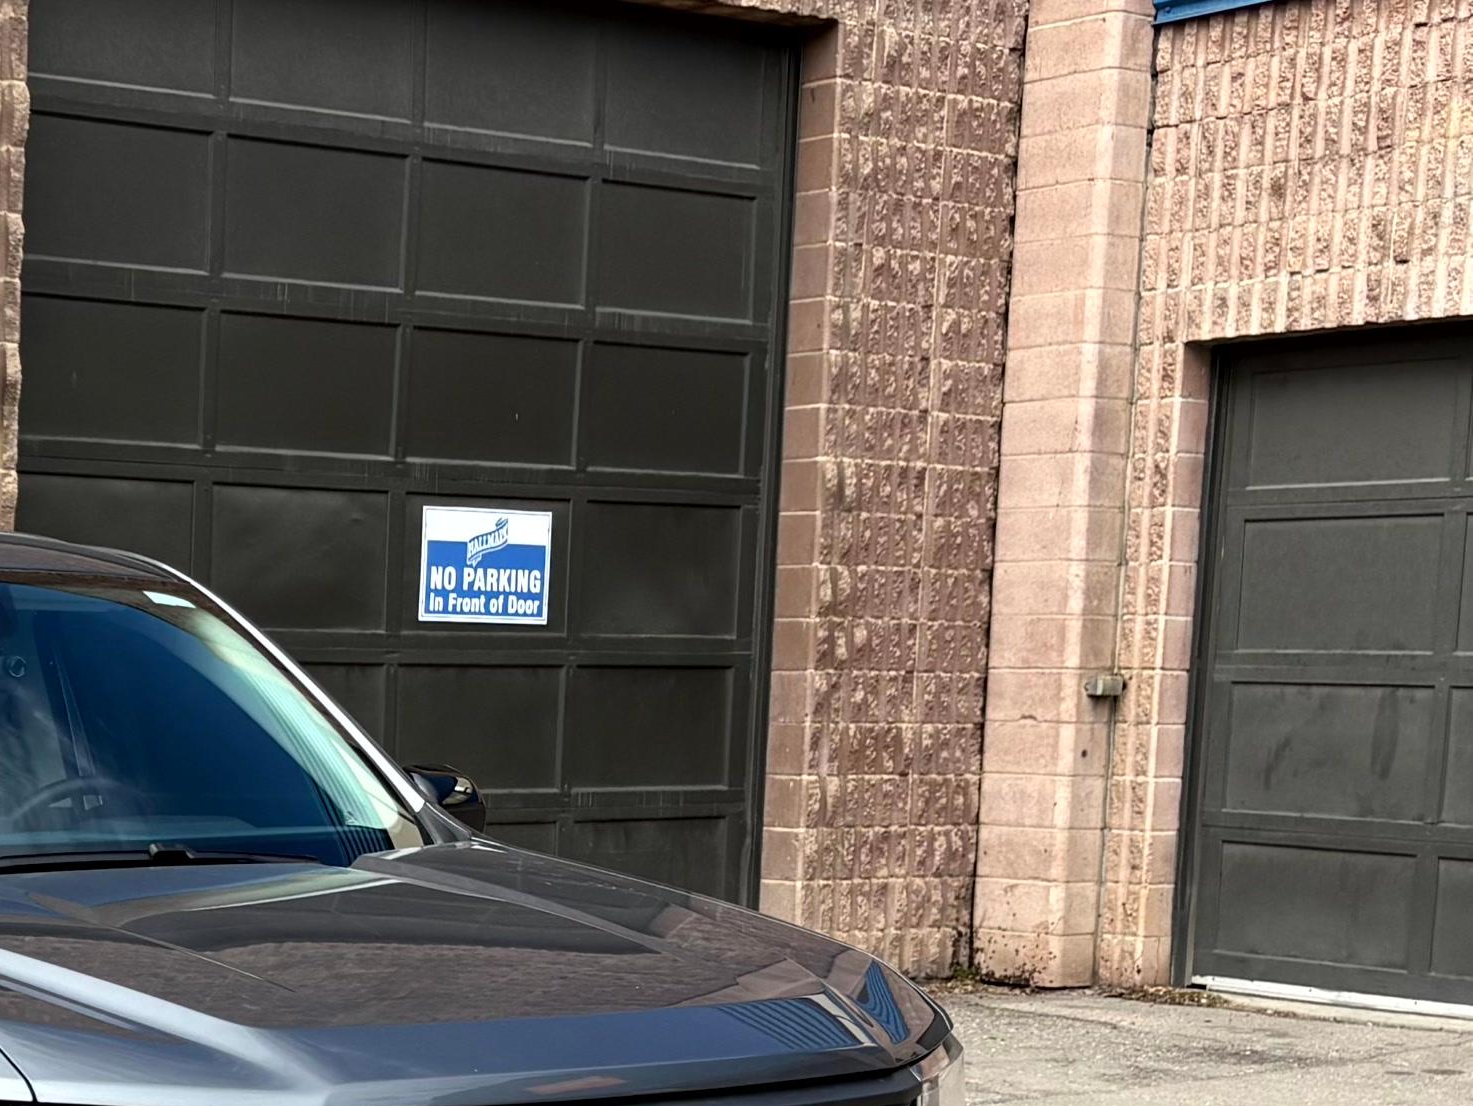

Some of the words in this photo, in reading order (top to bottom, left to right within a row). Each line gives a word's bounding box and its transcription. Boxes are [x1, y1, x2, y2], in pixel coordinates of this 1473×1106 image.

[430, 566, 457, 591] NO
[463, 567, 542, 594] PARKING
[429, 592, 444, 612] In
[448, 592, 486, 614] Front
[489, 594, 504, 614] of
[507, 595, 540, 615] Door
